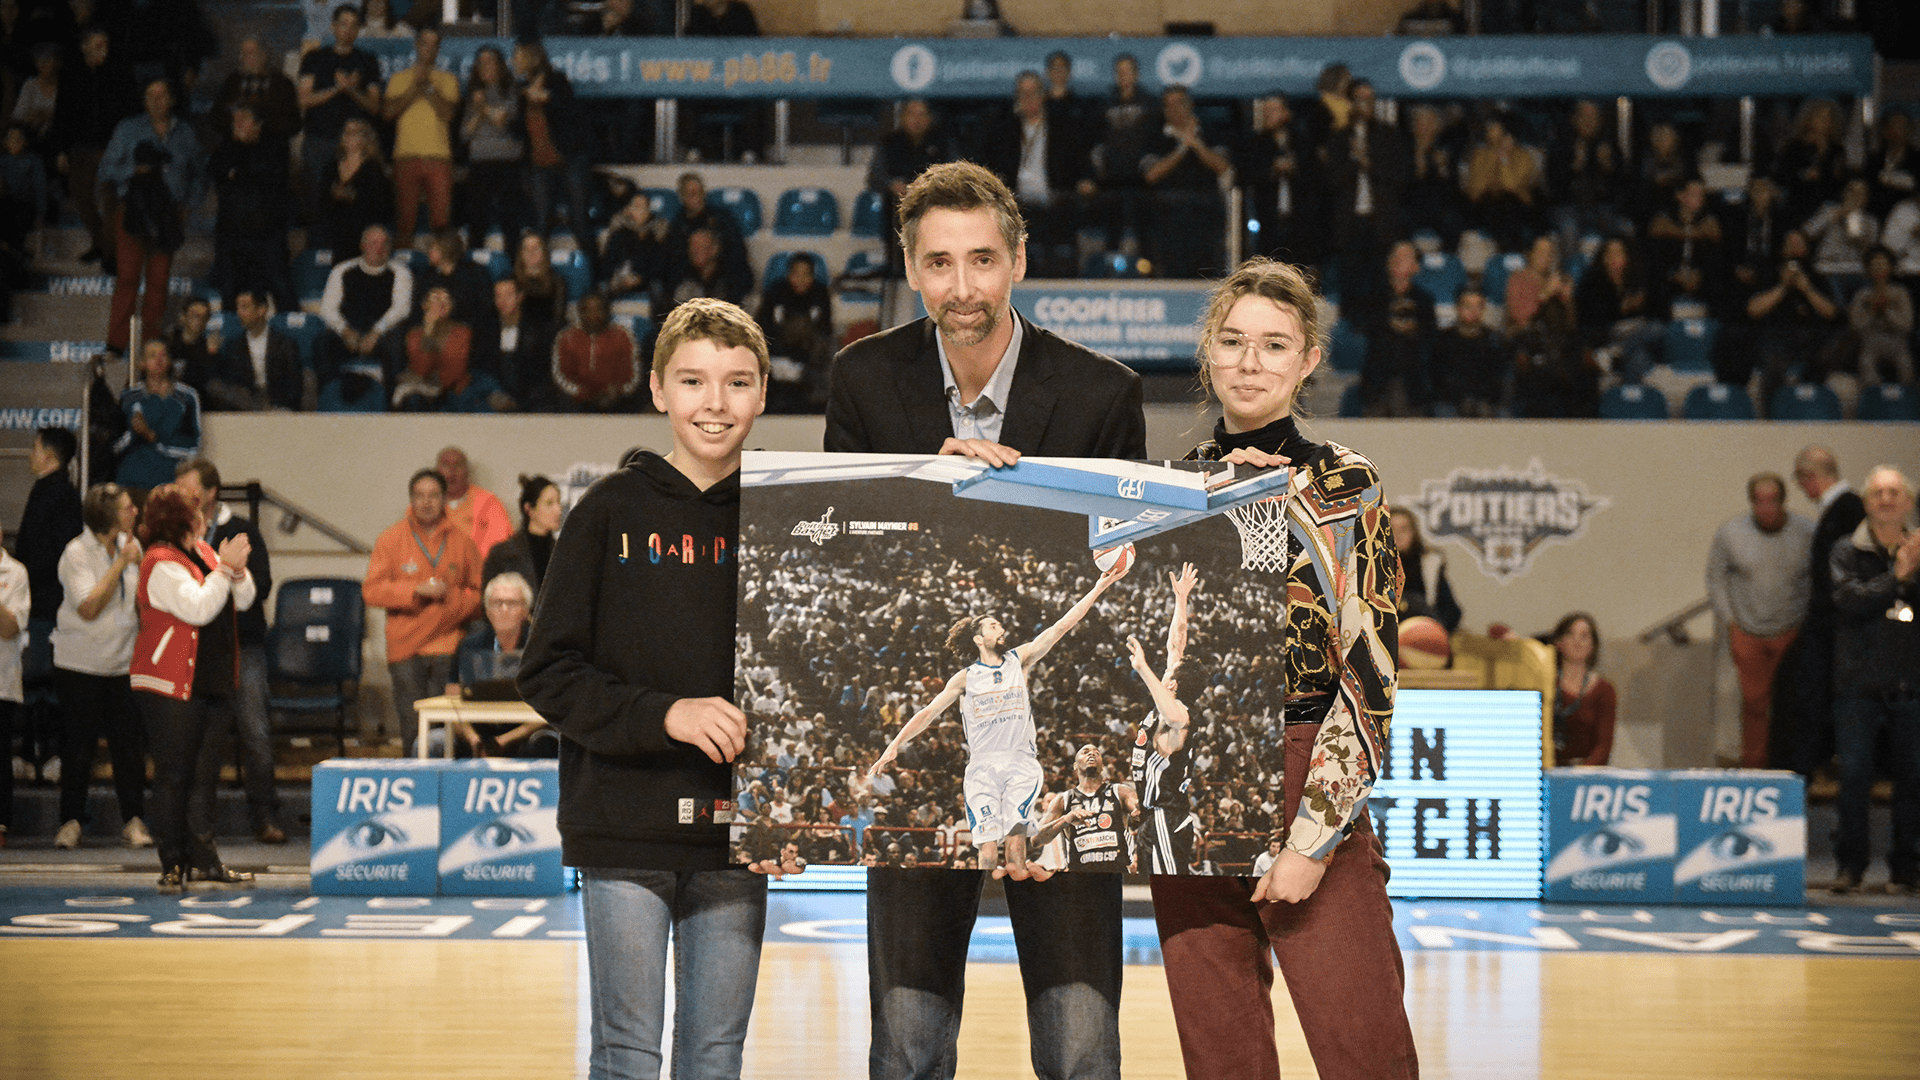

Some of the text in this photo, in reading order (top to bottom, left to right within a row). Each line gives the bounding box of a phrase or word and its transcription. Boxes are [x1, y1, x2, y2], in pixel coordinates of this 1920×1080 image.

[640, 53, 832, 89] www.pb86.fr
[849, 521, 877, 530] SYLVAIN
[878, 522, 907, 531] MAYNIER
[1429, 491, 1579, 530] POITIERS
[336, 777, 416, 813] IRIS
[463, 778, 543, 813] IRIS
[1570, 785, 1652, 822] IRIS
[1699, 786, 1781, 823] IRIS
